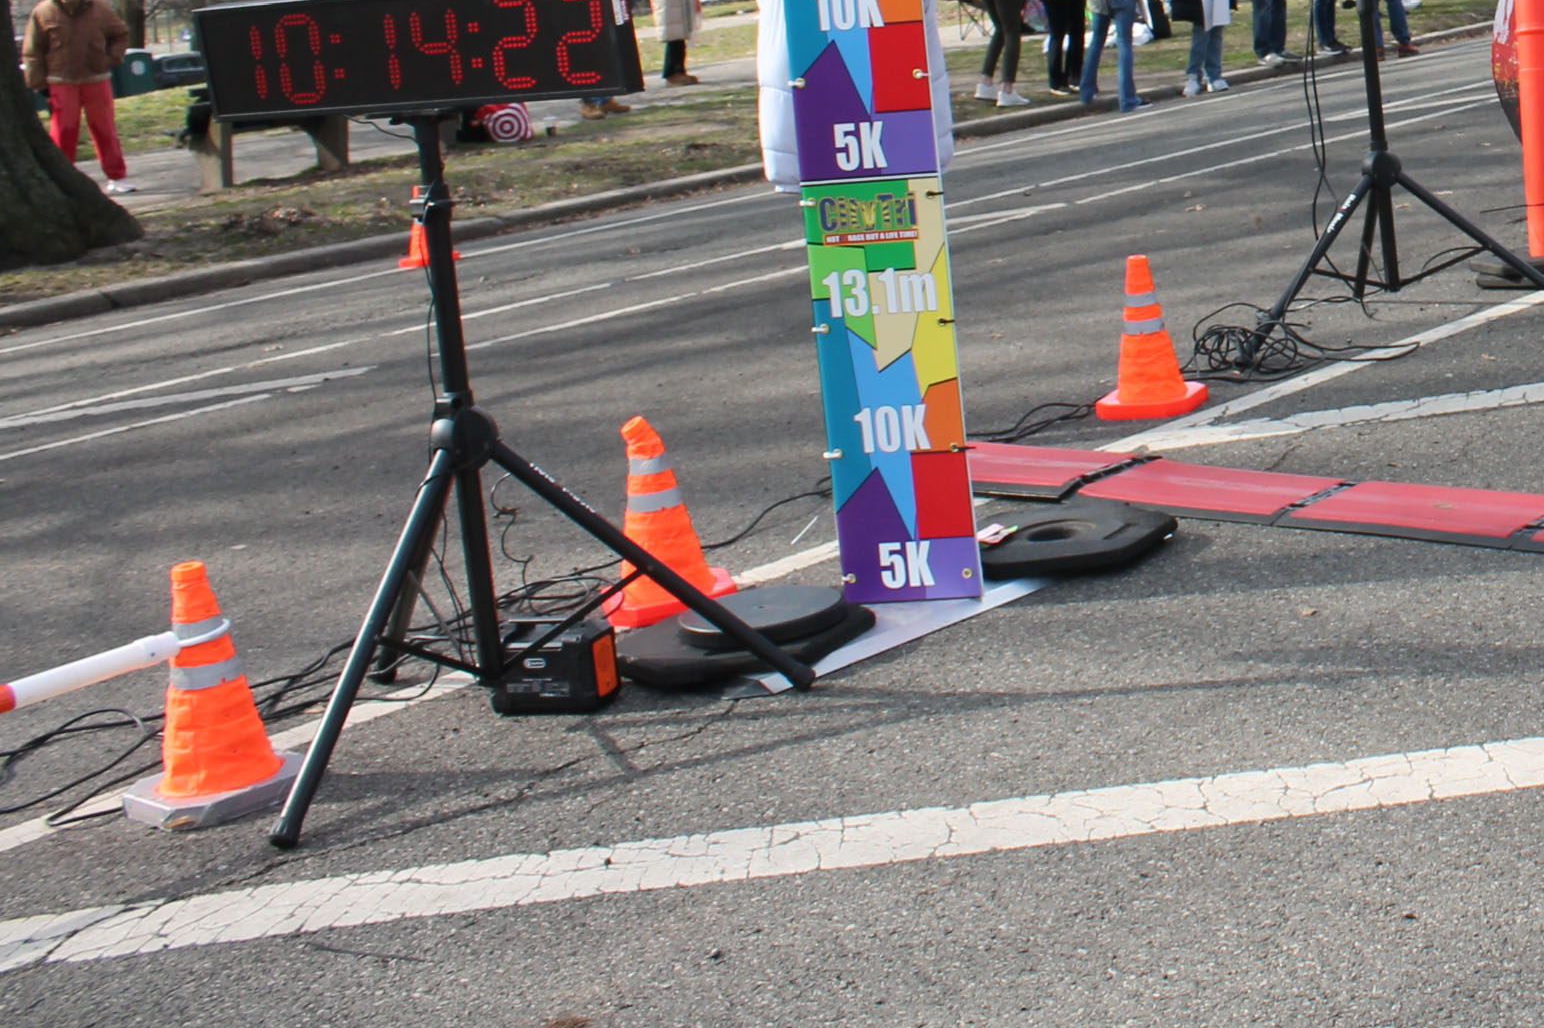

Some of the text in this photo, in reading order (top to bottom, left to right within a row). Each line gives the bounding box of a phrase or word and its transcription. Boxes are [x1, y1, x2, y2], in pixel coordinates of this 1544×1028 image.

[833, 120, 889, 171] 5K
[822, 266, 938, 319] 13.1m
[854, 403, 931, 455] 10K
[877, 540, 936, 589] 5K
